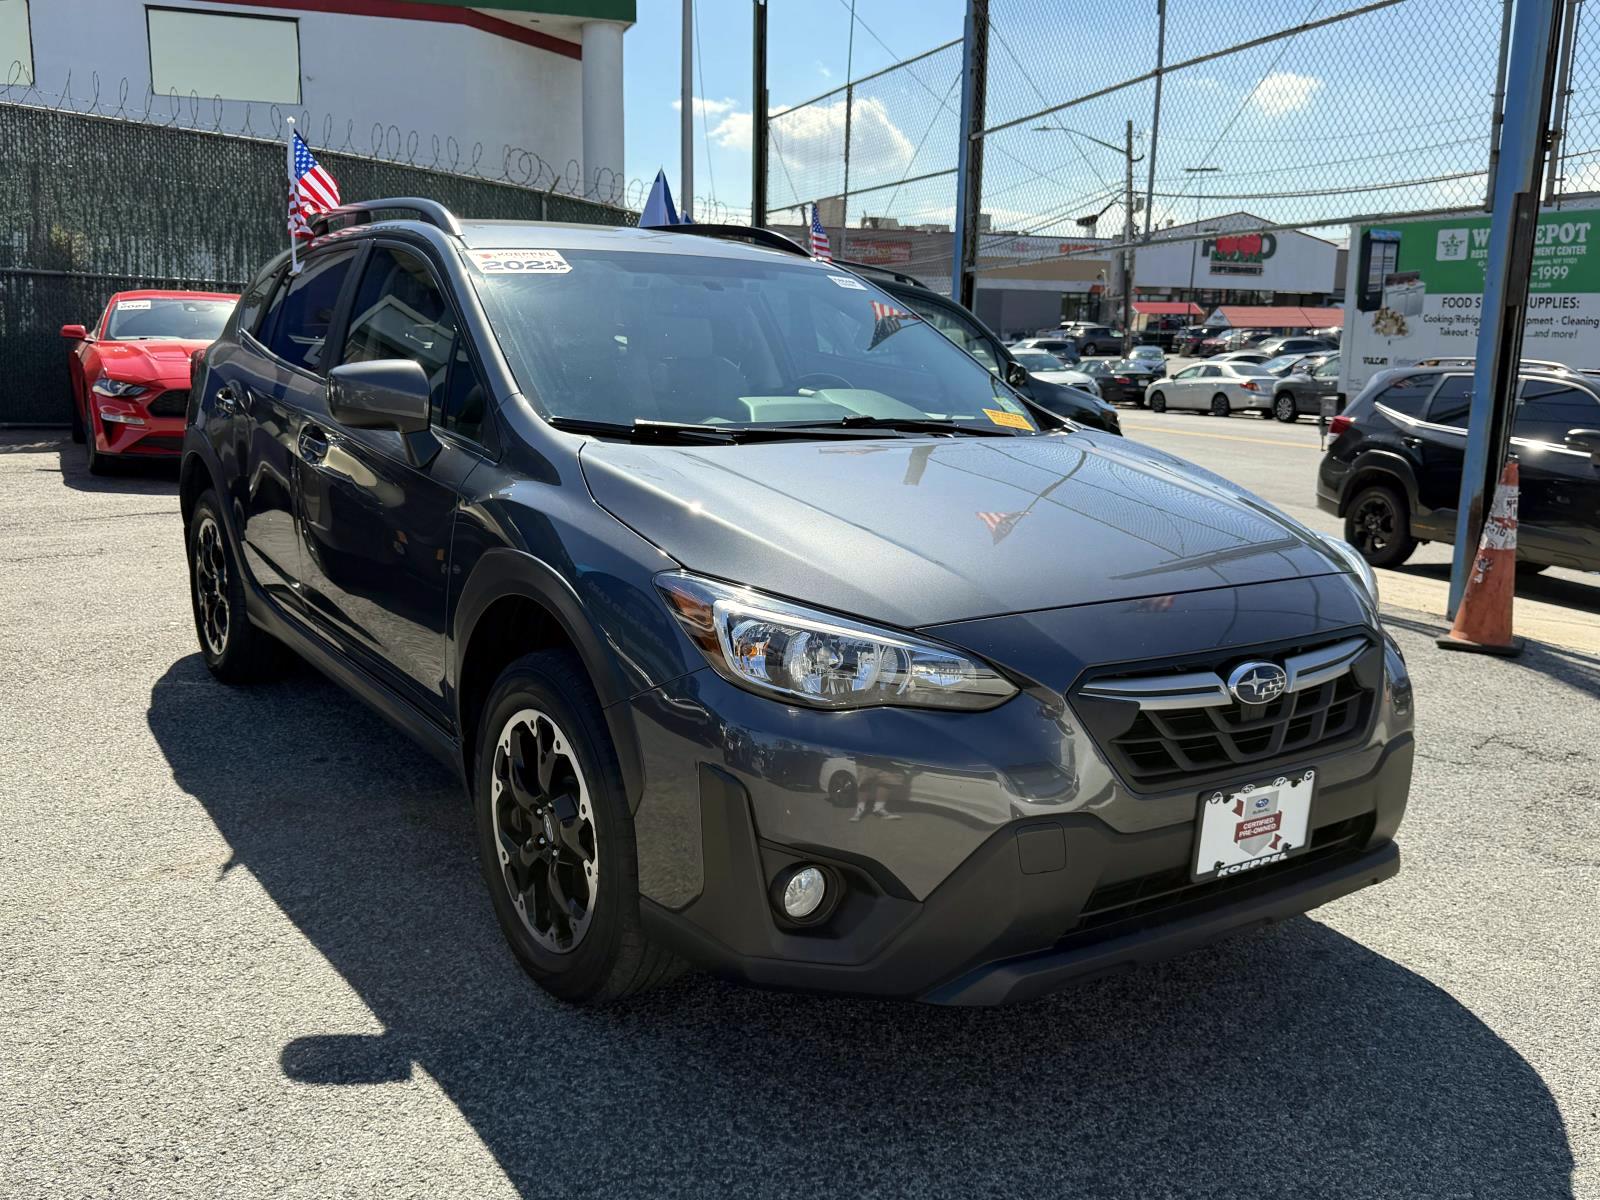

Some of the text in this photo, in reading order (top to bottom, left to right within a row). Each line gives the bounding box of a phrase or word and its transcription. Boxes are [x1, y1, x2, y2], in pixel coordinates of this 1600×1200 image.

[1535, 222, 1591, 245] EPOT
[1556, 246, 1586, 256] CENTER
[1442, 297, 1472, 308] FOOD
[1527, 296, 1580, 309] UPPLIES:
[1561, 315, 1600, 328] Cleaning
[1440, 327, 1468, 336] Takeout
[1551, 330, 1578, 339] more!
[1239, 823, 1277, 837] PRE-OWNED
[1243, 817, 1275, 830] CERTIFIED
[1217, 852, 1287, 877] KOEPPEL
